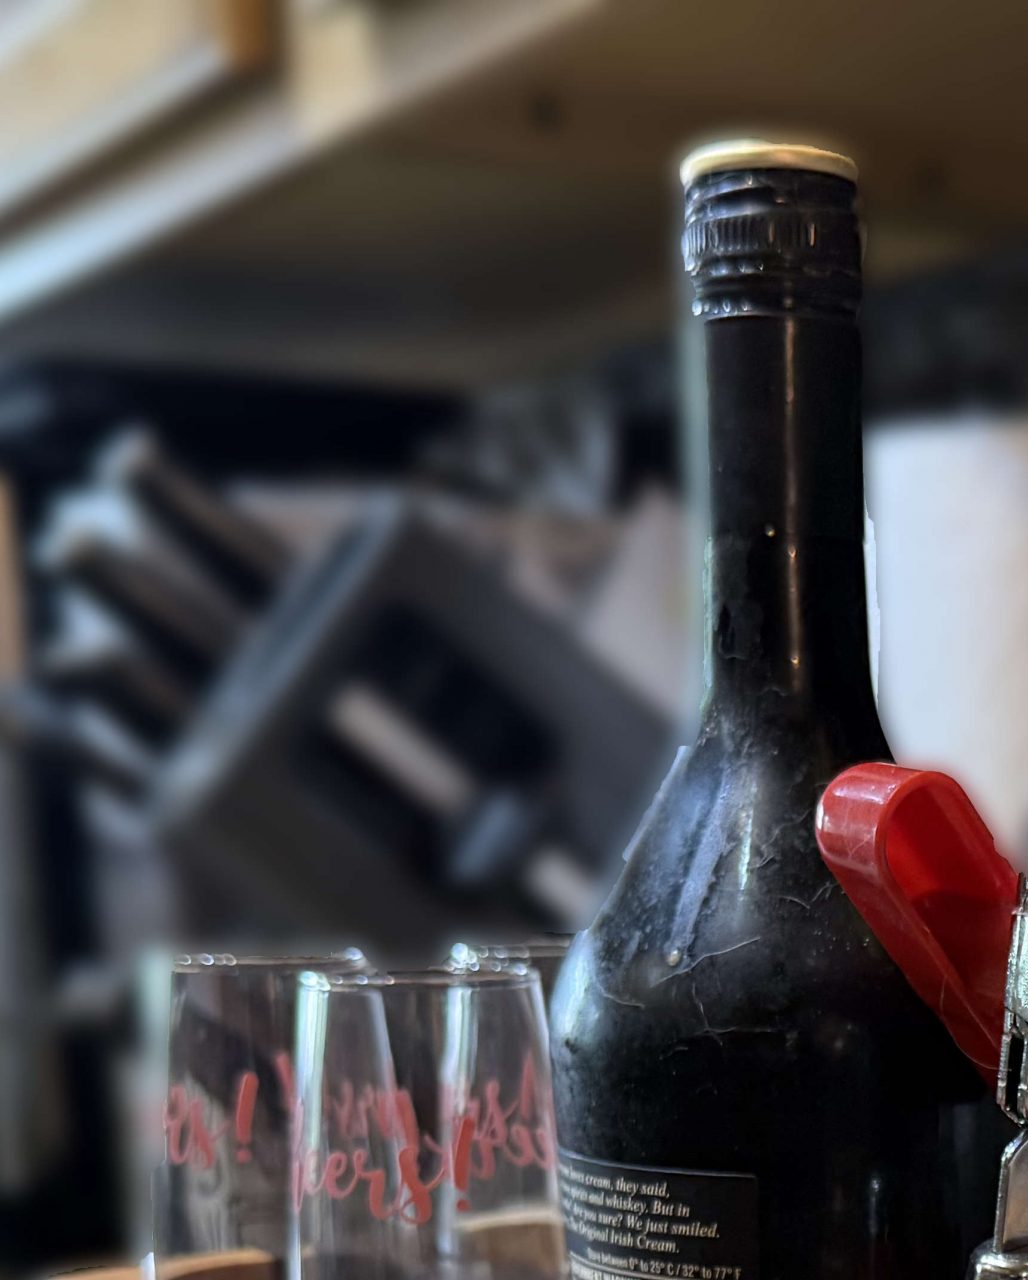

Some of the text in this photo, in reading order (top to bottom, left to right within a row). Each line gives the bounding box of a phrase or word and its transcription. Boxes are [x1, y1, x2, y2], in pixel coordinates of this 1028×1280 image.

[616, 1177, 639, 1197] they
[641, 1182, 670, 1199] said,
[605, 1195, 649, 1216] whiskey.
[652, 1200, 674, 1217] But
[677, 1203, 690, 1217] in
[627, 1215, 643, 1231] We
[643, 1218, 669, 1235] just
[671, 1221, 720, 1238] smiled.
[610, 1228, 634, 1247] Irish
[637, 1235, 680, 1254] Cream.
[640, 1259, 649, 1272] to
[650, 1261, 665, 1274] 25°
[667, 1263, 674, 1276] C
[682, 1264, 700, 1278] 32°
[702, 1266, 712, 1279] to
[714, 1267, 733, 1280] 77°
[735, 1268, 741, 1280] F
